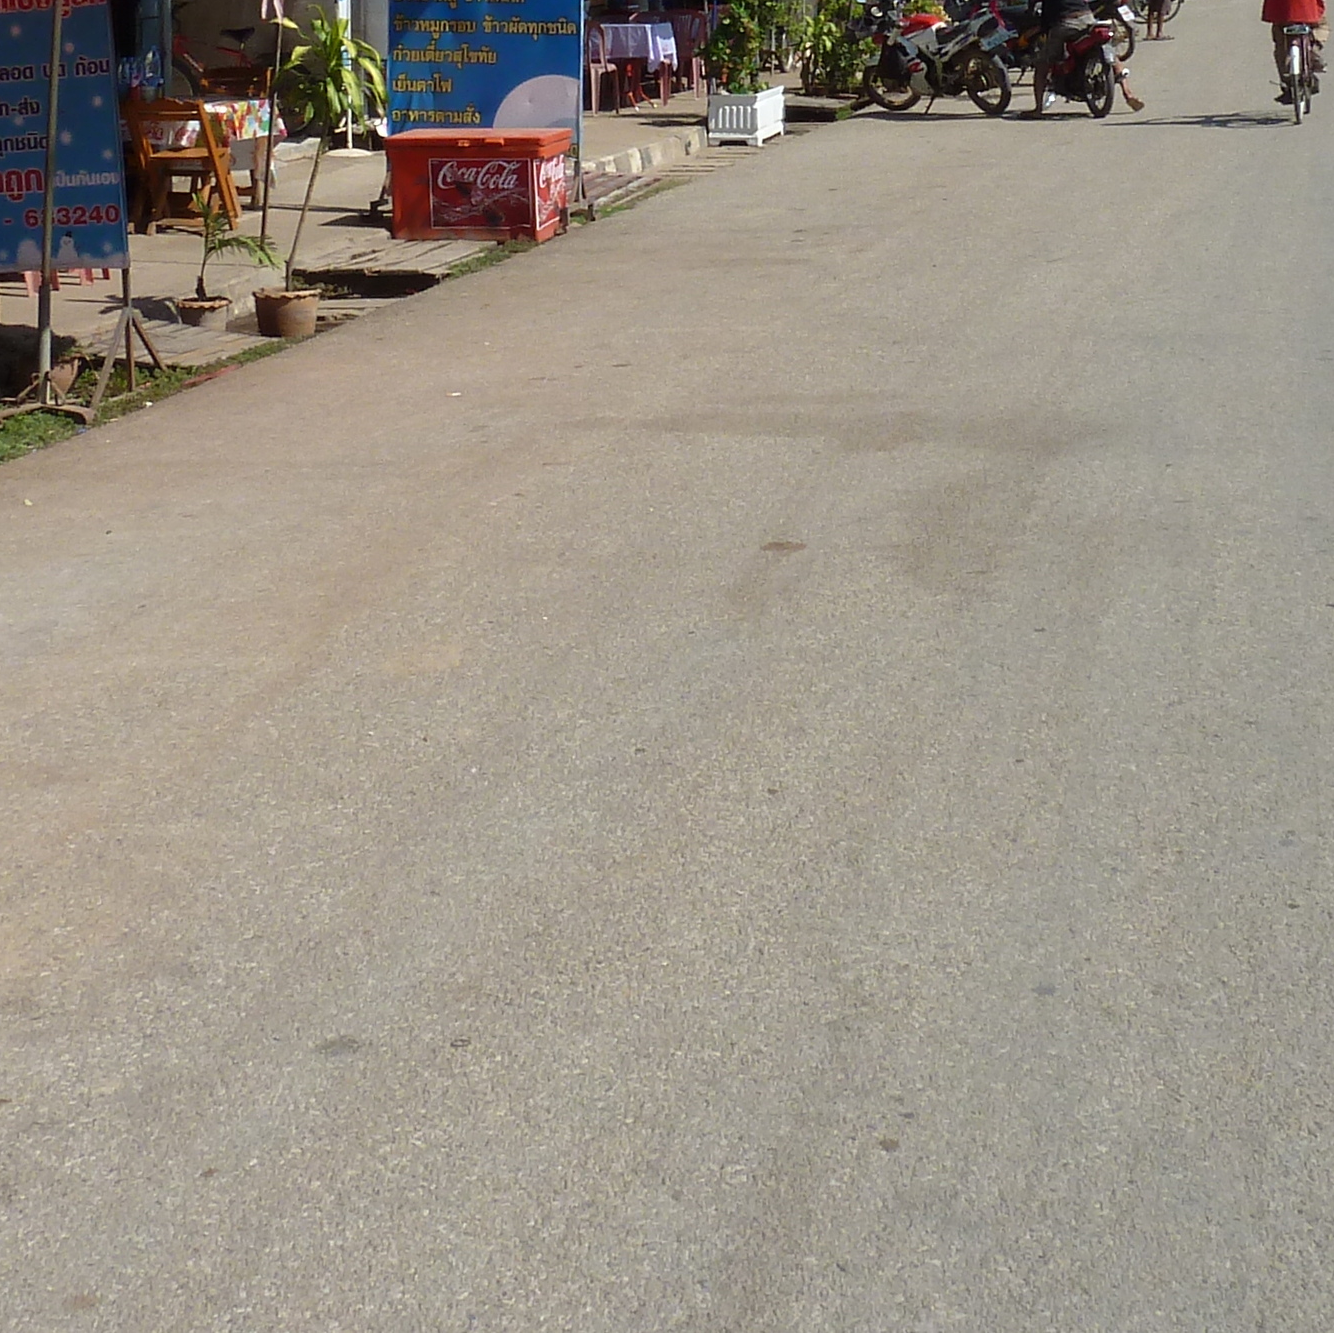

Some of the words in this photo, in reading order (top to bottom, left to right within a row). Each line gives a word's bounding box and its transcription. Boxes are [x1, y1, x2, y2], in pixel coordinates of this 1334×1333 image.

[393, 14, 477, 40] ข้าวหมูกรอบ
[482, 14, 577, 41] ข้าวผัดทุกชนิด
[74, 55, 110, 77] ก้อน
[391, 101, 482, 125] อาหารตามสั่ง
